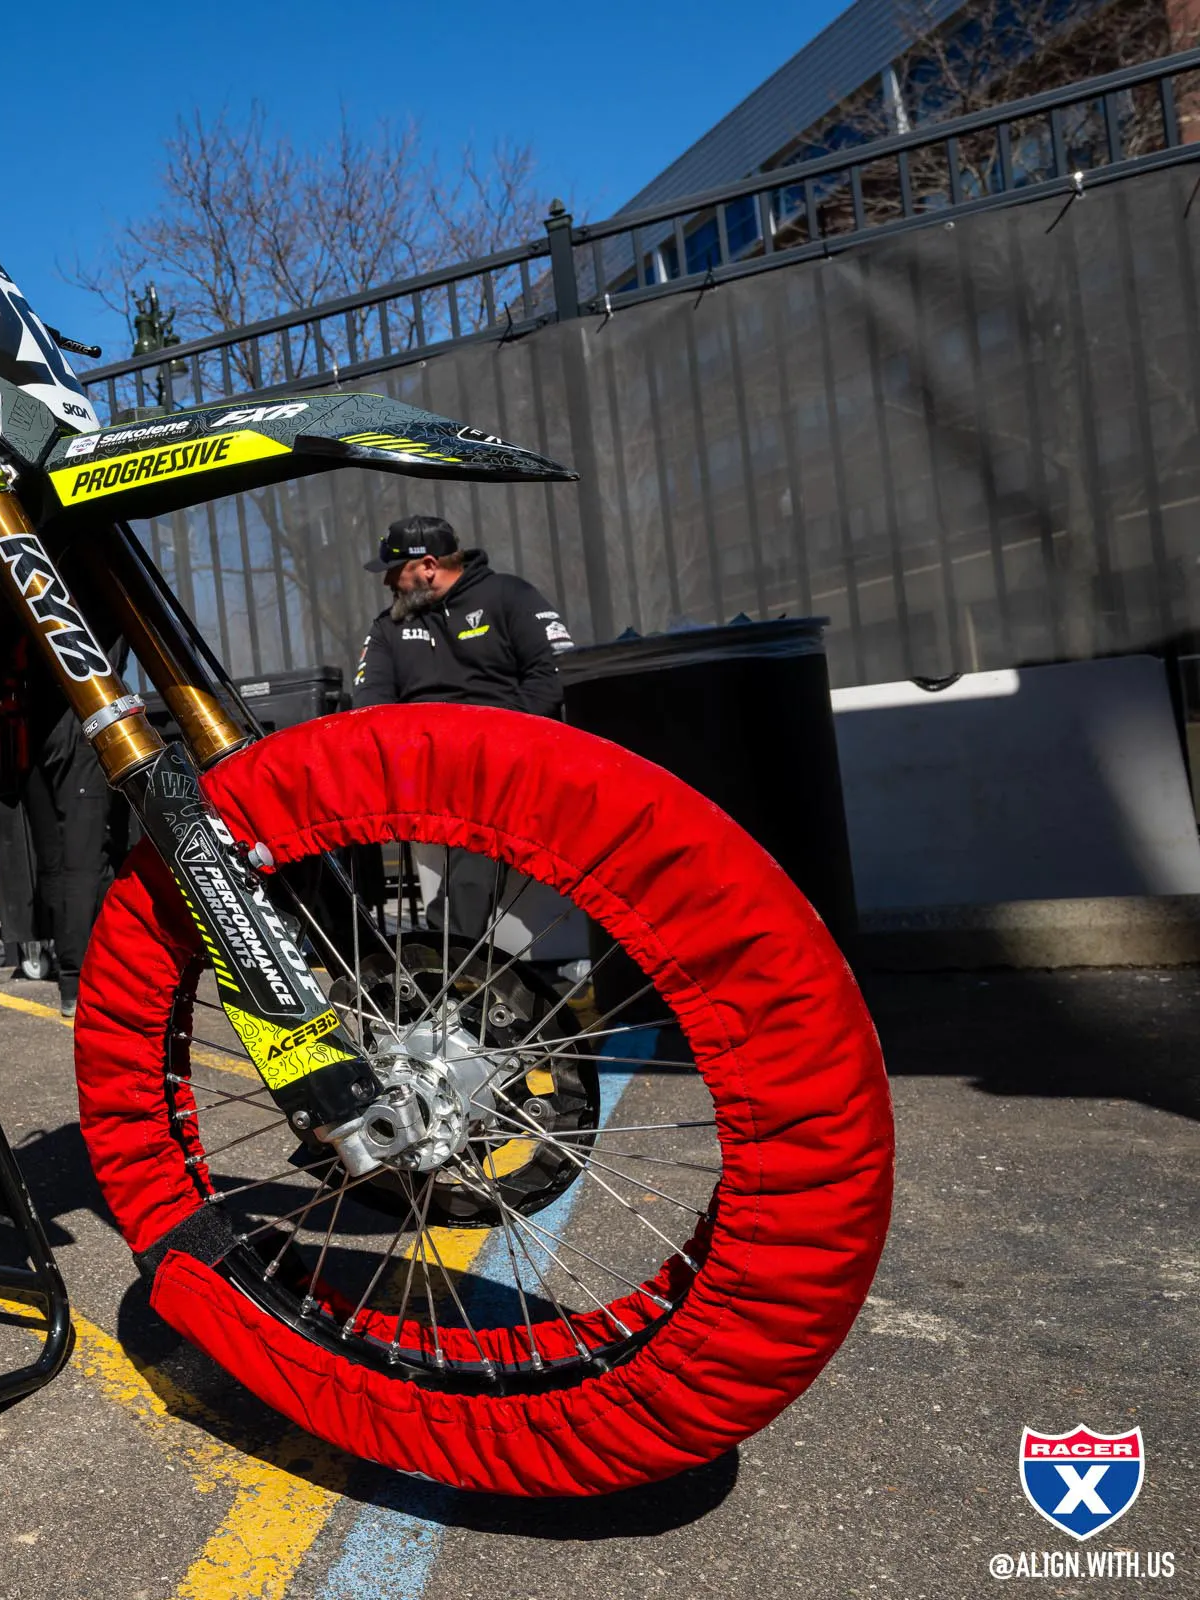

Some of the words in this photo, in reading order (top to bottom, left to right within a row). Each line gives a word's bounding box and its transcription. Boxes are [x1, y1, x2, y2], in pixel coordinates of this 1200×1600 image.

[210, 402, 310, 429] FXR
[71, 438, 234, 497] PROGRESSIVE
[72, 439, 95, 450] FUCHS
[402, 628, 424, 640] 5.11
[188, 866, 257, 969] LUBRICANTS
[204, 866, 297, 1006] PERFORMANCE
[267, 1013, 338, 1061] ACERBIS
